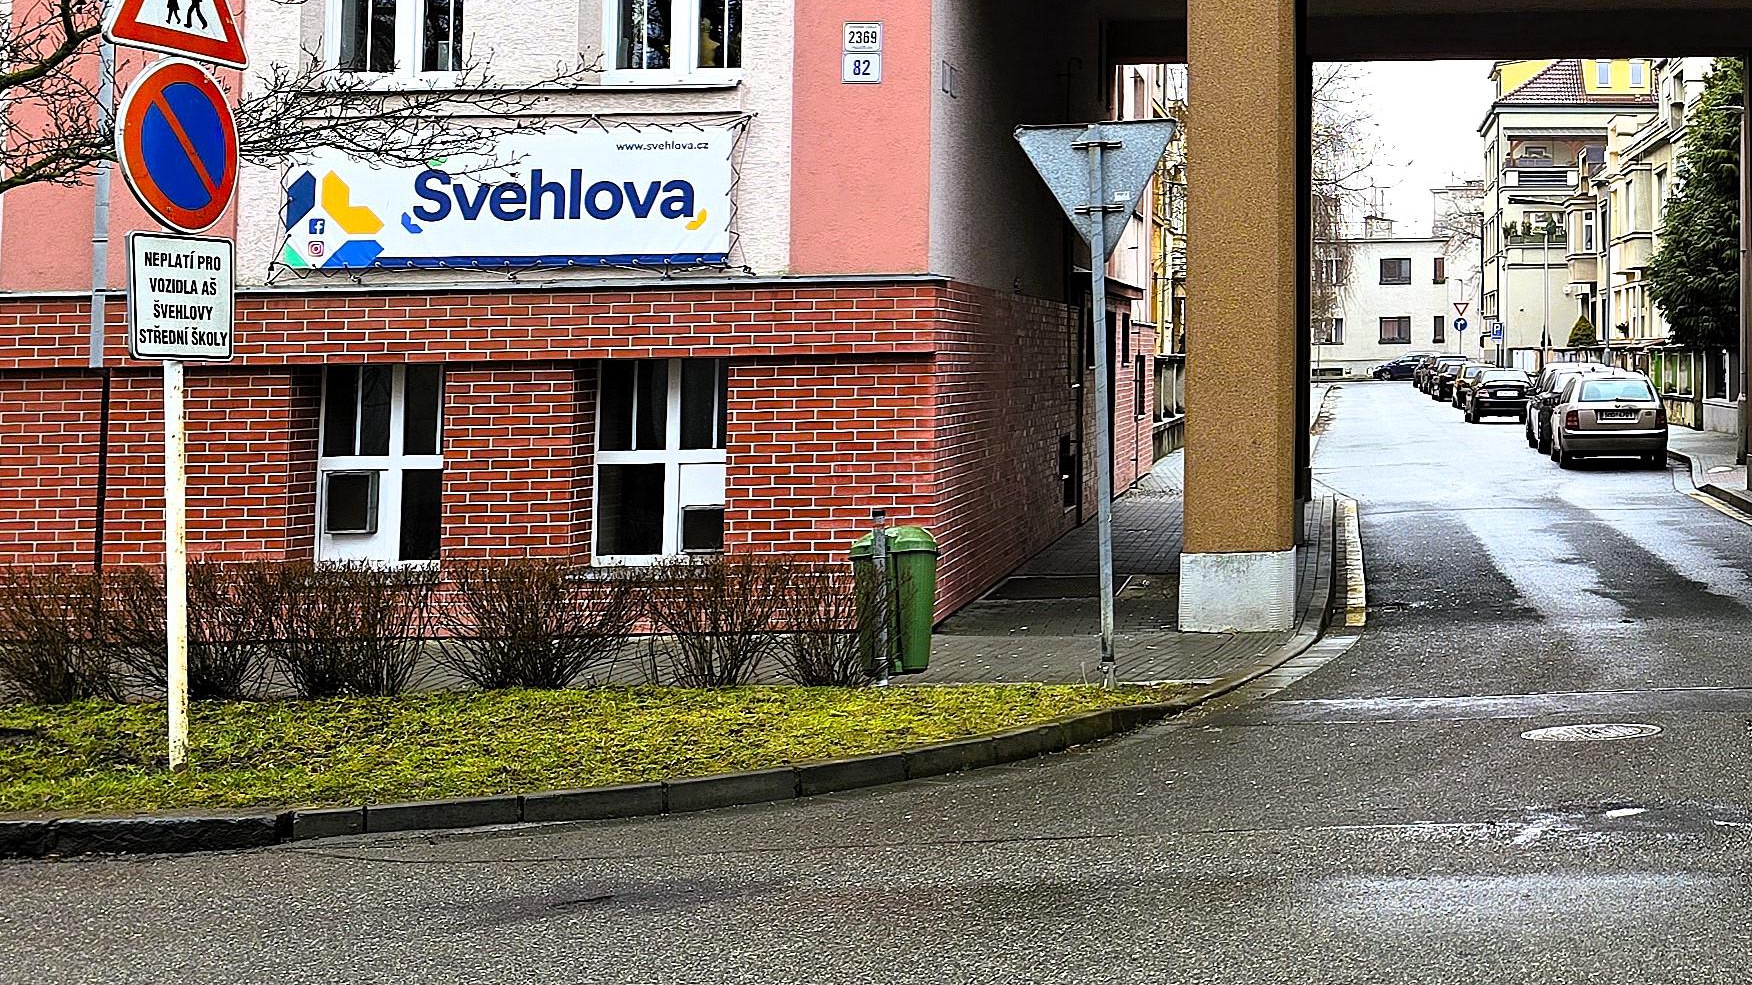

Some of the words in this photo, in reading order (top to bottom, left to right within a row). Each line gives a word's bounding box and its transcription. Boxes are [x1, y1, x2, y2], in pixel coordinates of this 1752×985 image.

[848, 30, 877, 44] 2369
[853, 59, 871, 76] 82
[615, 140, 709, 151] www.svehlova.cz
[144, 251, 196, 270] NEPLATÍ
[197, 255, 221, 271] PRO
[149, 277, 198, 295] VOZIDLA
[201, 277, 217, 296] AŠ
[153, 299, 214, 321] ŠVEHLOVY
[139, 325, 189, 346] STŘEDNÍ
[191, 327, 228, 347] ŠKOLY
